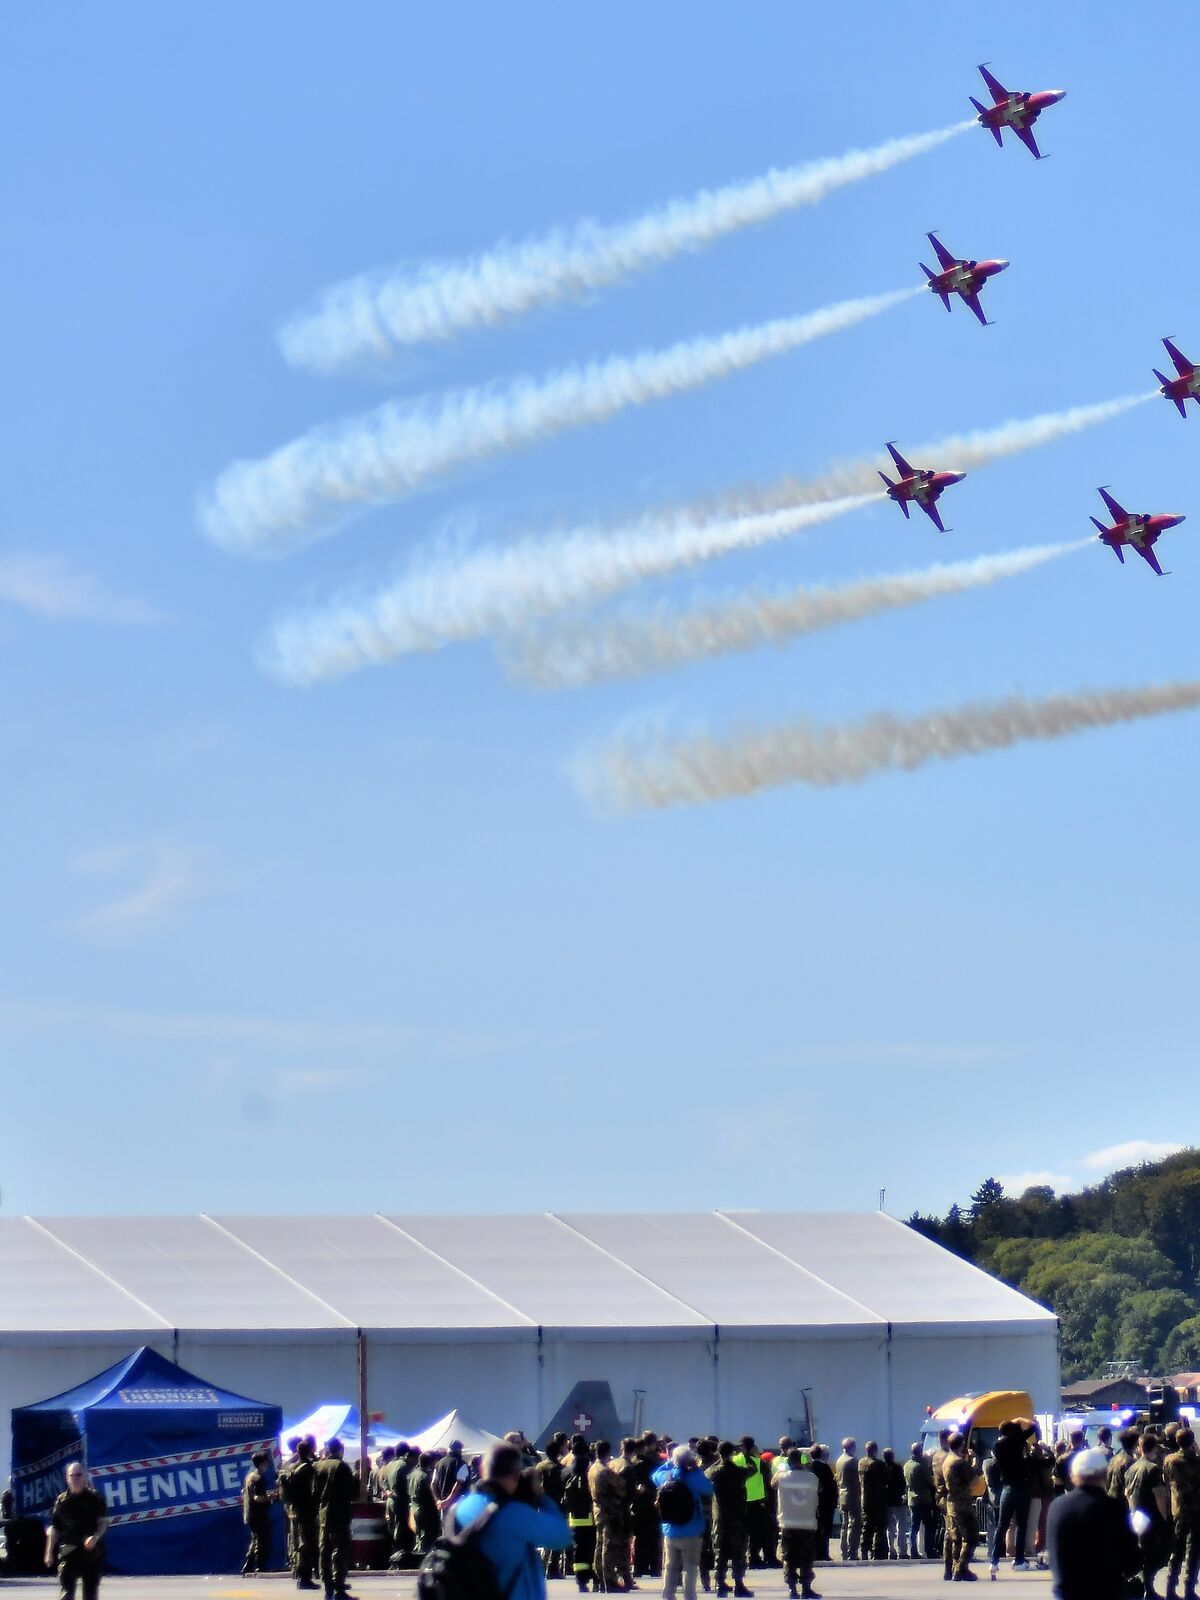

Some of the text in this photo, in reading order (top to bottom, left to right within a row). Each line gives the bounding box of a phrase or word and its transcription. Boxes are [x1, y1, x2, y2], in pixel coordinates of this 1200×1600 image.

[130, 1391, 209, 1401] HENNIEZ
[222, 1416, 260, 1424] HENNIEZ
[23, 1468, 65, 1509] HENN
